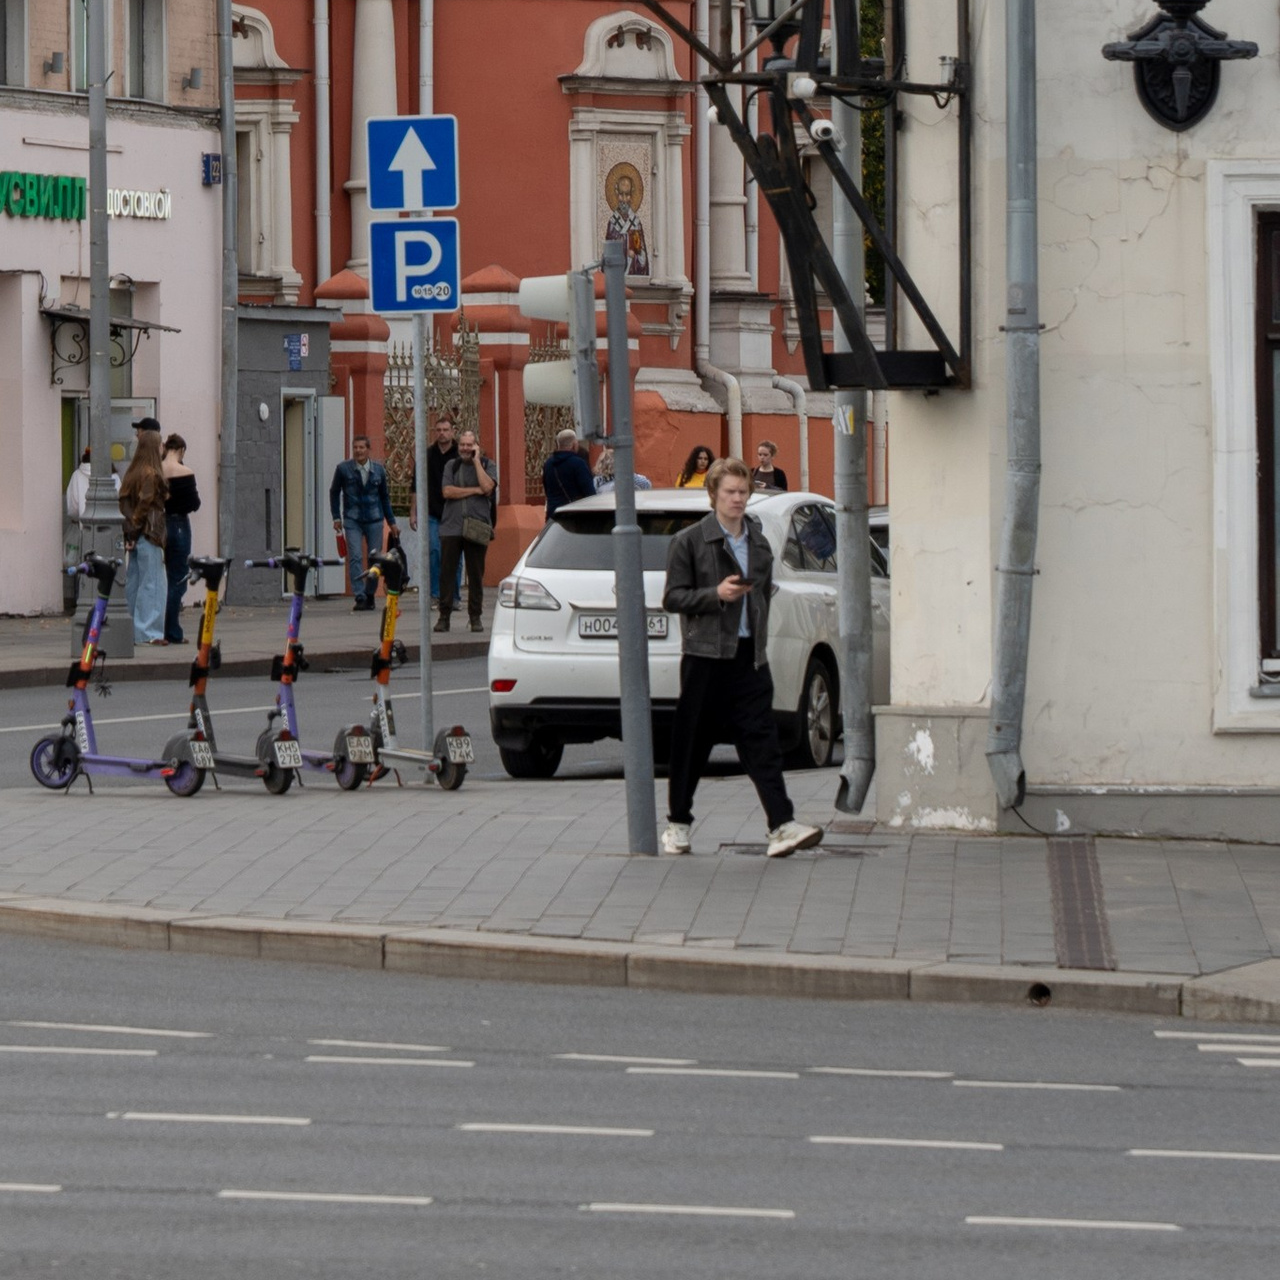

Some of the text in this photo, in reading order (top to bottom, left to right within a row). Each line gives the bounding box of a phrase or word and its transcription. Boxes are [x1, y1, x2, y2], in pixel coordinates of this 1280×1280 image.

[395, 230, 442, 302] P
[413, 285, 450, 297] 10 15 20
